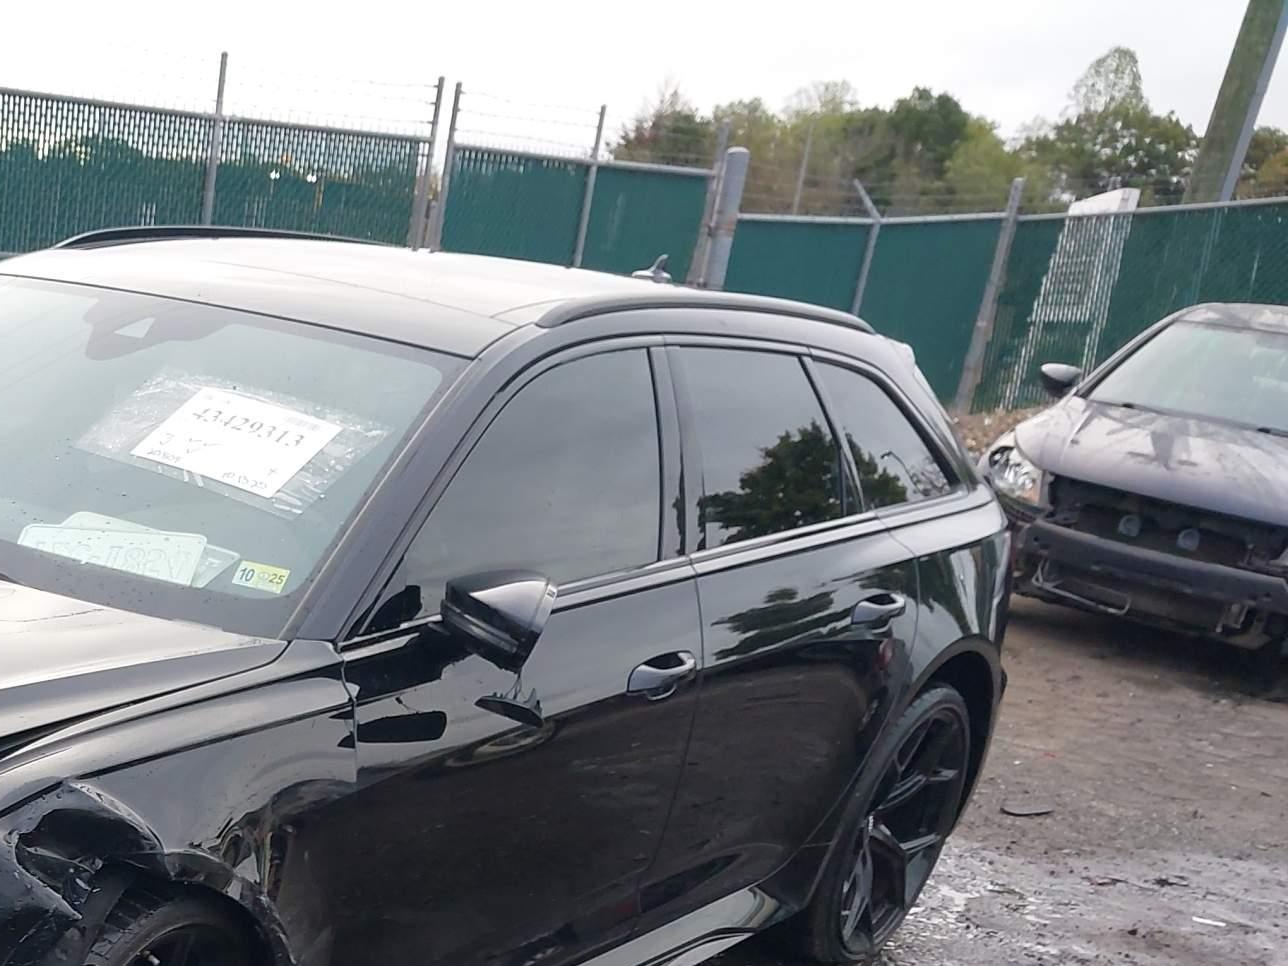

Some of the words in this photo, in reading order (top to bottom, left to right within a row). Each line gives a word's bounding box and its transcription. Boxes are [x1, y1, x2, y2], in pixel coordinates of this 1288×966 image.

[192, 407, 305, 447] 43429313
[239, 567, 255, 582] 10
[268, 573, 286, 585] 25
